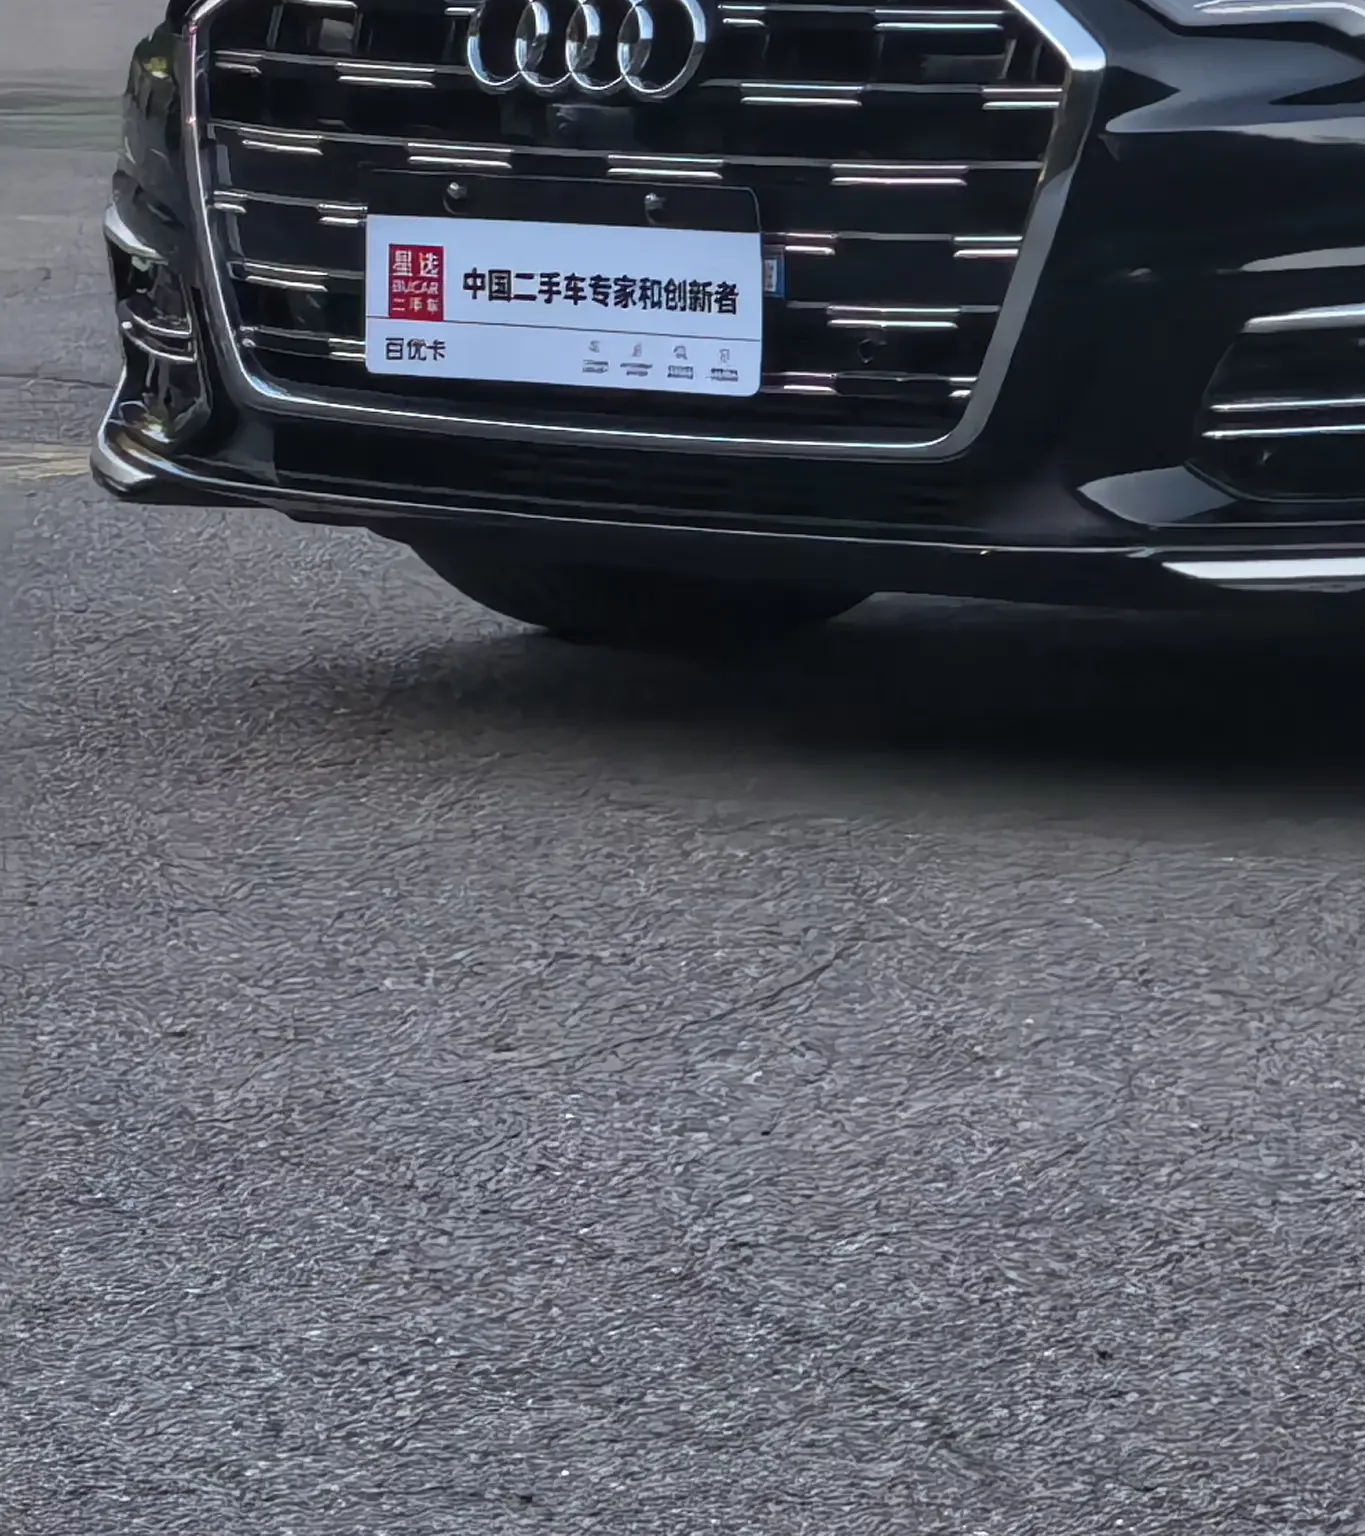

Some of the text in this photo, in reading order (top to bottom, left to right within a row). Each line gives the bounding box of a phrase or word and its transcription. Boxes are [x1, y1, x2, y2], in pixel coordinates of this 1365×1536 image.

[462, 267, 739, 315] 中国二手车专家和创新者
[385, 338, 446, 361] 百优卡
